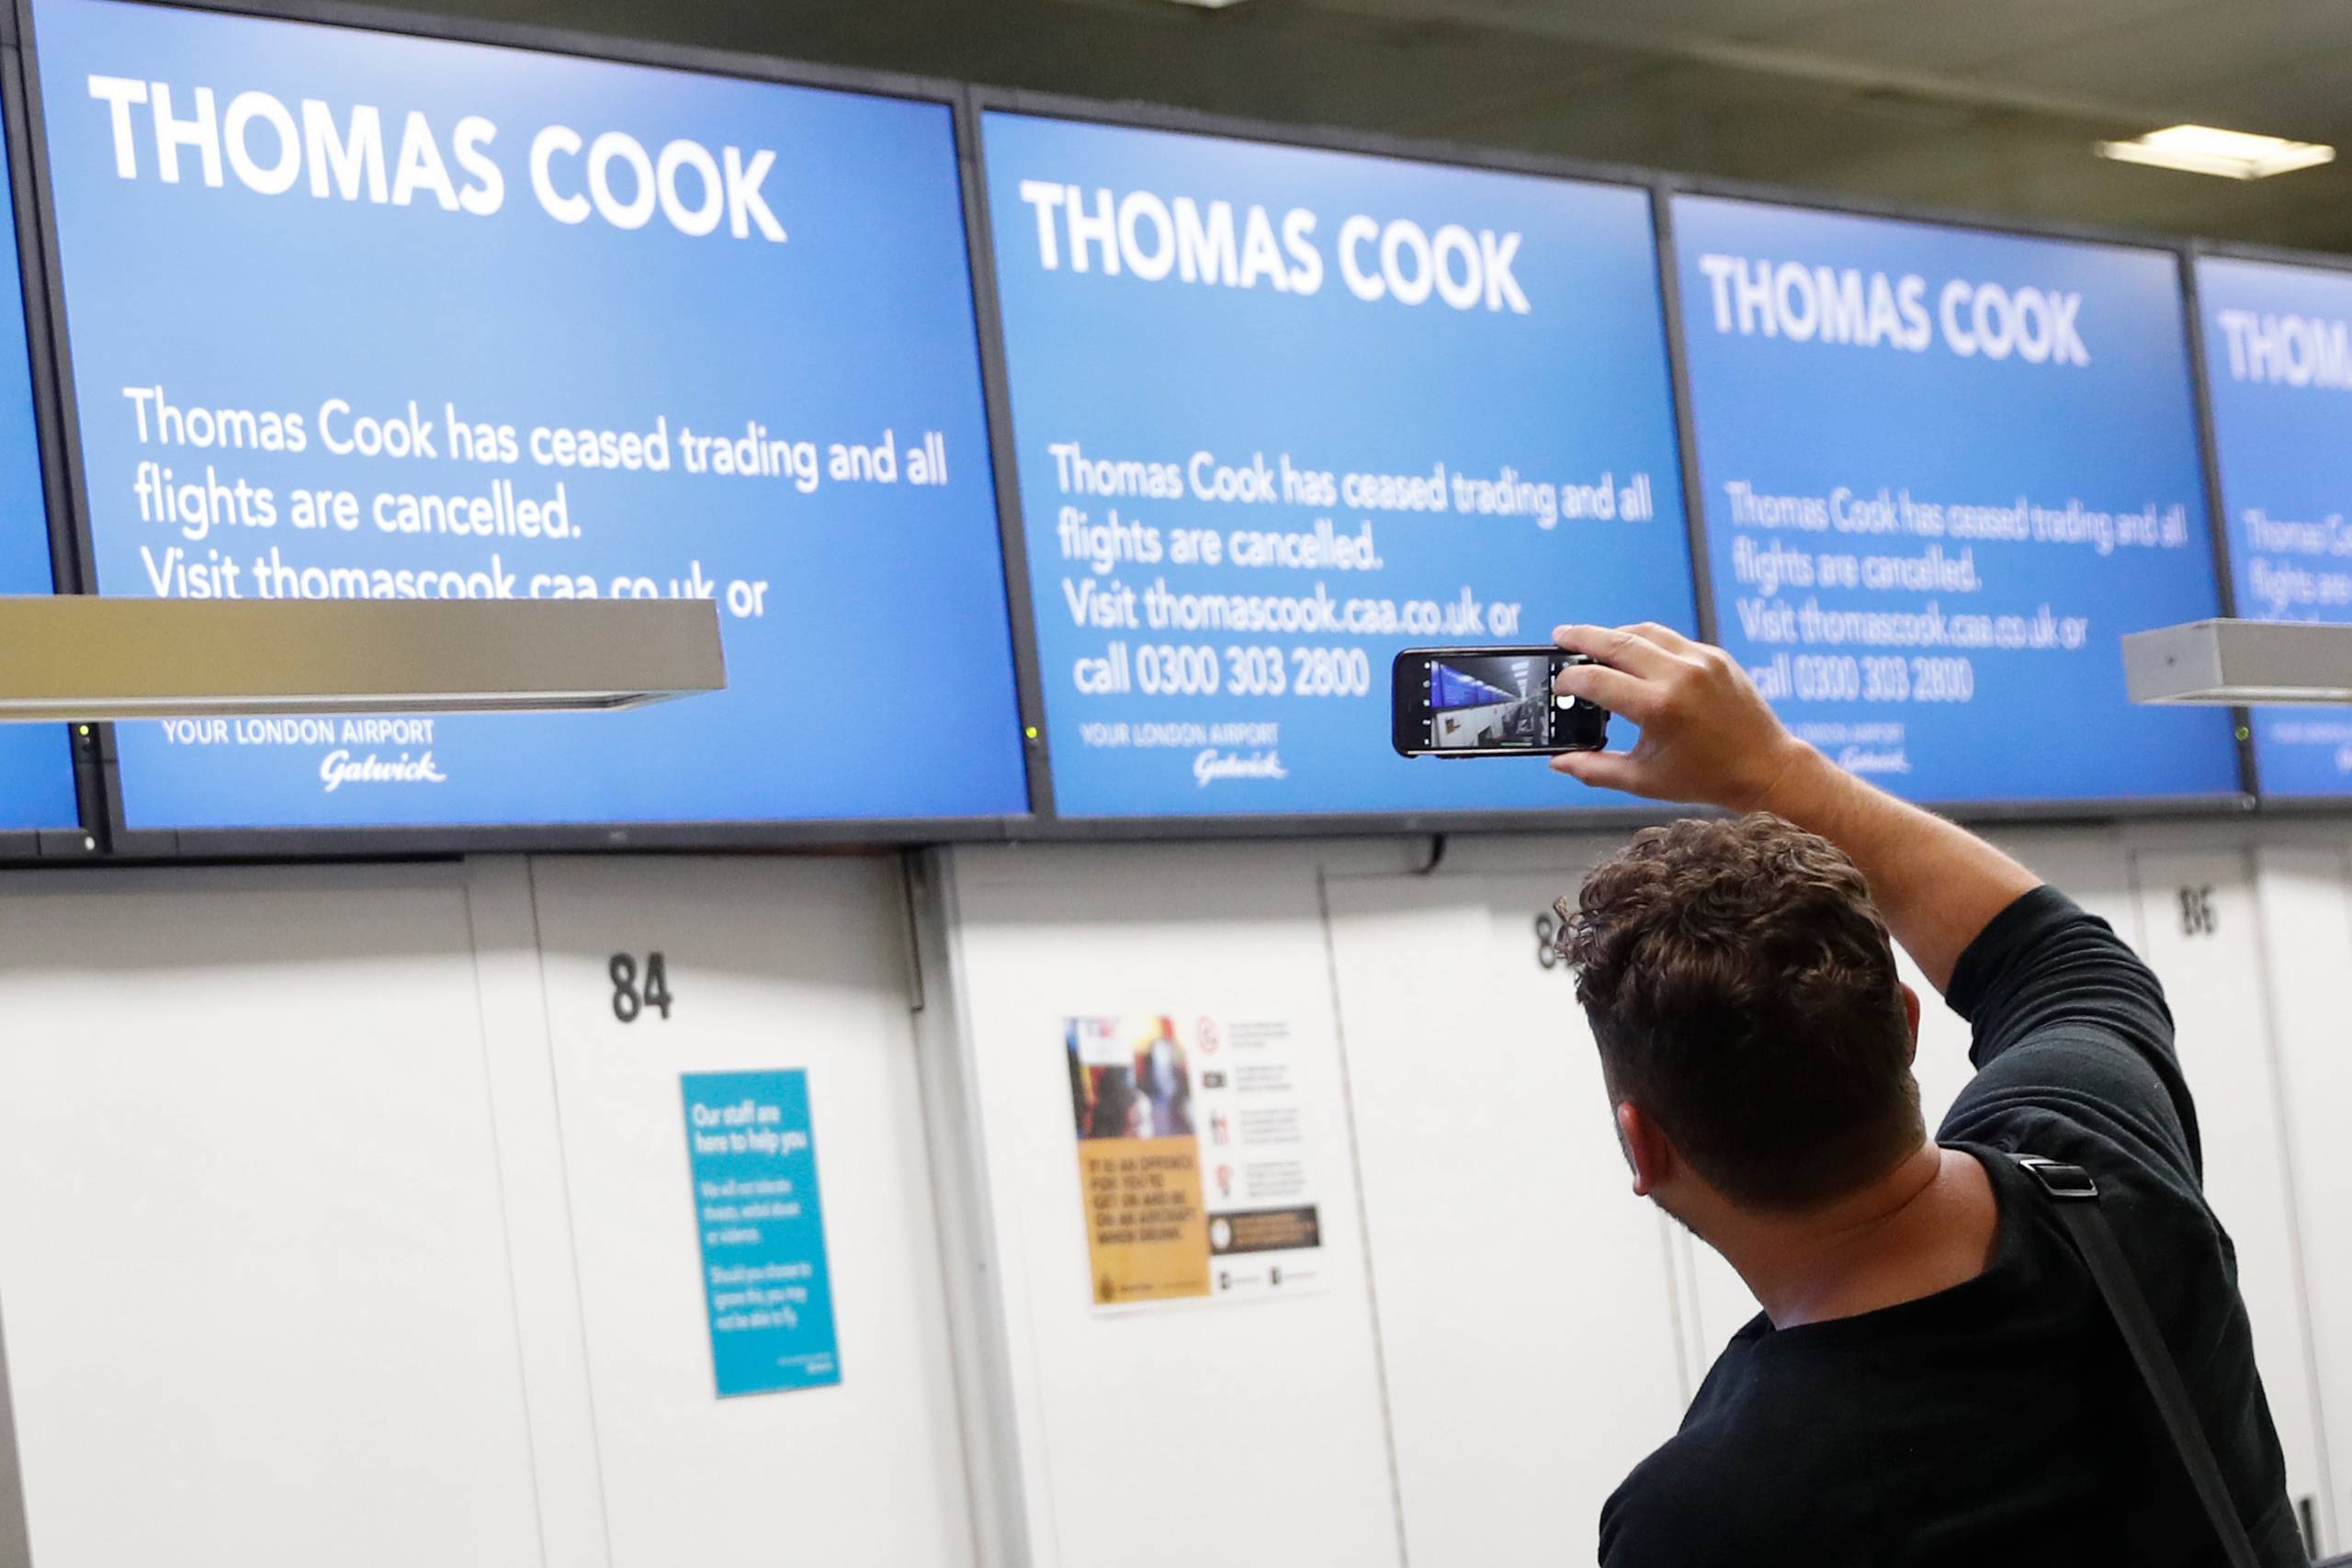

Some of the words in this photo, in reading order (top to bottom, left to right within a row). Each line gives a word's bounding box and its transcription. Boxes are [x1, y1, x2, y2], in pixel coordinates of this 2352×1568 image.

[88, 74, 504, 216] THOMAS
[530, 125, 787, 243] COOK
[1020, 179, 1324, 296] THOMAS
[1339, 214, 1532, 314] COOK
[1699, 253, 1932, 353] THOMAS
[1939, 279, 2090, 366] COOK
[2216, 308, 2352, 390] THOM
[123, 386, 307, 453] Thomas
[318, 398, 437, 461] Cook
[446, 403, 519, 466] has
[530, 415, 671, 471] ceased
[678, 420, 819, 493] trading
[829, 428, 898, 483] and
[906, 431, 948, 485] all
[134, 461, 277, 542] flights
[290, 485, 359, 530] are
[373, 479, 582, 538] cancelled.
[1049, 442, 1183, 499] Thomas
[1189, 451, 1277, 503] Cook
[1282, 455, 1337, 507] has
[1341, 462, 1448, 513] ceased
[1453, 466, 1556, 530] trading
[1561, 470, 1614, 522] and
[1619, 472, 1654, 523] all
[1724, 479, 1828, 532] Thomas
[1829, 485, 1897, 535] Cook
[1899, 489, 1943, 536] has
[1946, 495, 2030, 541] ceased
[2031, 499, 2113, 556] trading
[2116, 502, 2156, 548] and
[2159, 504, 2188, 548] all
[1057, 506, 1161, 574] flights
[1169, 526, 1224, 565] are
[1227, 519, 1384, 572] cancelled.
[1732, 536, 1815, 596] flights
[1817, 555, 1859, 589] are
[1861, 545, 1983, 593] cancelled.
[140, 546, 243, 599] Visit
[727, 579, 768, 618] or
[1062, 577, 1139, 630] Visit
[1145, 577, 1485, 637] thomascook.caa.co.uk
[1488, 602, 1521, 637] or
[1736, 595, 1798, 644] Visit
[1800, 599, 2057, 650] thomascook.caa.co.uk
[2060, 615, 2089, 649] or
[1074, 641, 1131, 695] call
[1136, 644, 1219, 696] 0300
[1227, 646, 1286, 697] 303
[1294, 647, 1371, 698] 2800
[1793, 655, 1860, 702] 0300
[1861, 656, 1909, 702] 303
[1910, 657, 1974, 703] 2800
[162, 719, 229, 745] YOUR
[235, 719, 335, 746] LONDON
[342, 719, 435, 745] AIRPORT
[1080, 721, 1131, 748] YOUR
[1133, 721, 1206, 748] LONDON
[1208, 721, 1279, 747] AIRPORT
[320, 749, 447, 793] Gatwick
[609, 952, 673, 1023] 84
[692, 1102, 720, 1127] Our
[721, 1100, 754, 1125] staff
[756, 1105, 779, 1122] are
[695, 1129, 729, 1153] here
[729, 1132, 747, 1152] to
[747, 1126, 779, 1156] help
[780, 1131, 808, 1156] you
